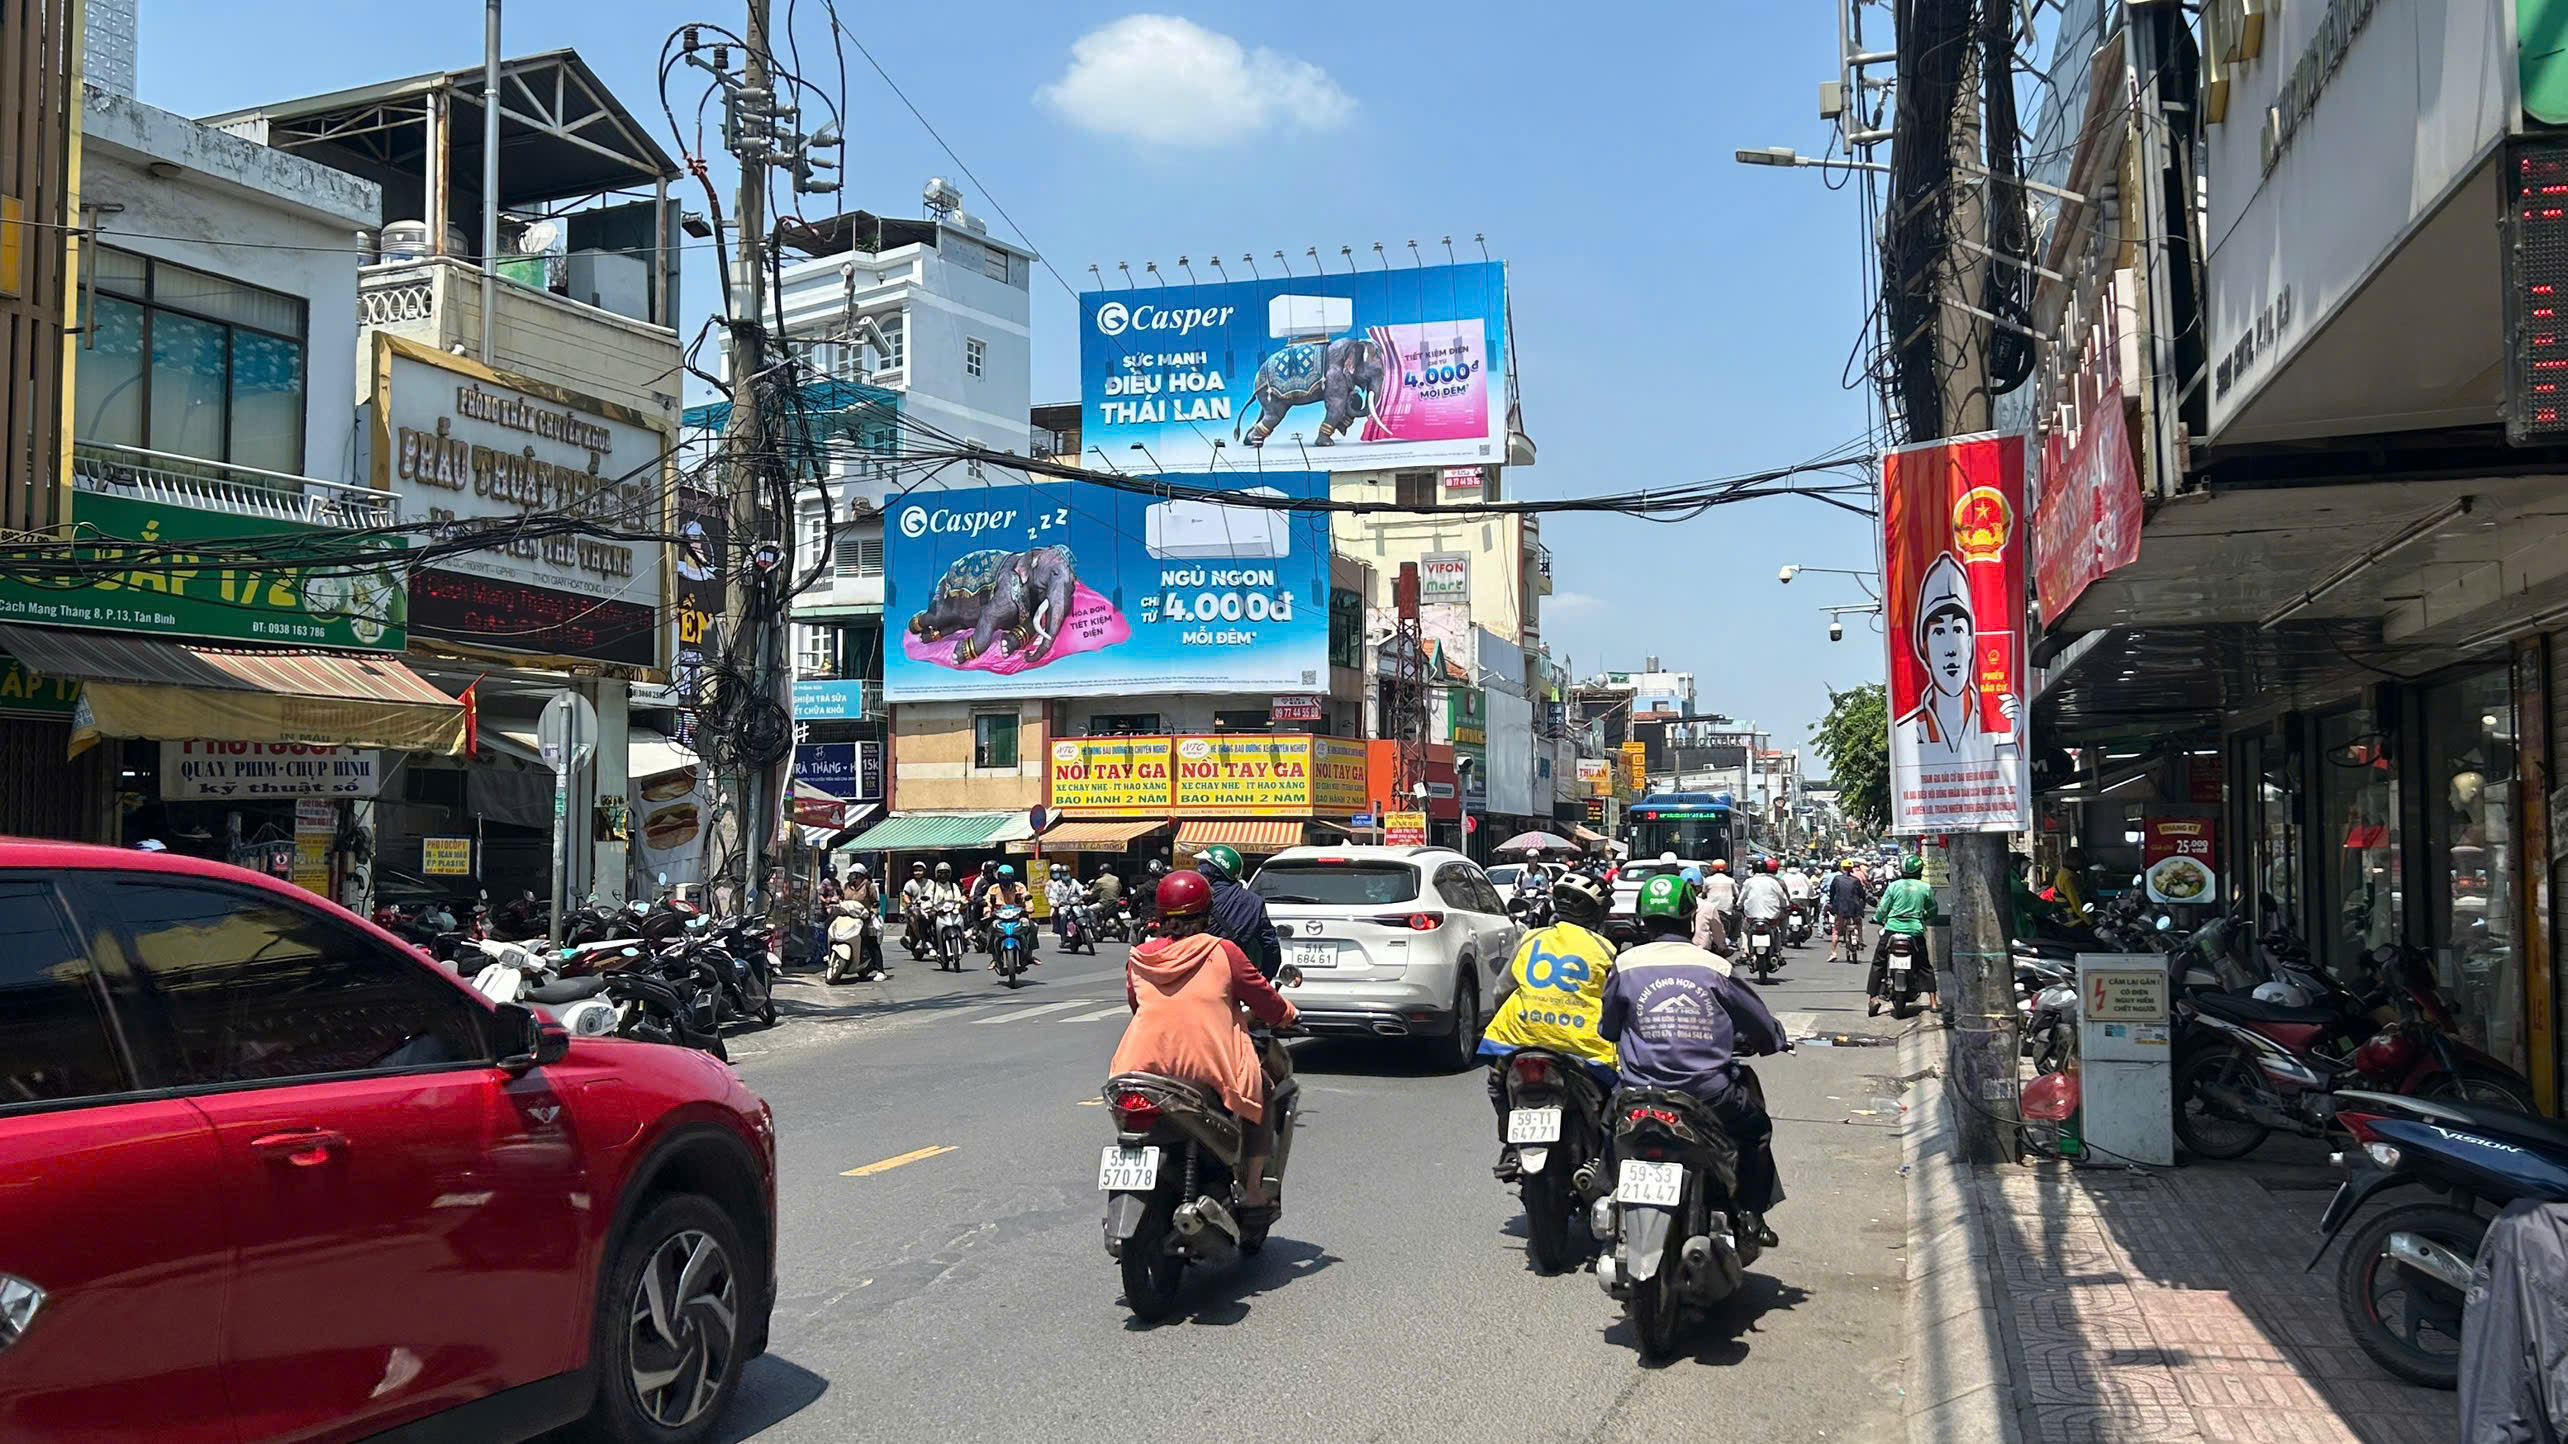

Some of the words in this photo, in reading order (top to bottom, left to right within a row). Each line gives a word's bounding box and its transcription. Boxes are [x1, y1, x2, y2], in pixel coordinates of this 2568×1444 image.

[1132, 305, 1234, 336] Casper
[1123, 351, 1153, 368] SỨC
[1158, 351, 1207, 369] MẠNH
[1105, 368, 1162, 397] ĐIỀU
[1168, 367, 1225, 393] HÒA
[1404, 360, 1479, 389] 4.000đ
[1100, 395, 1166, 425] THÁI
[1174, 397, 1232, 422] LAN
[929, 508, 1017, 538] Casper
[1160, 565, 1206, 588] NGỦ
[1211, 569, 1275, 588] NGON
[1427, 563, 1464, 574] VIFON
[1163, 590, 1294, 623] 4.000đ
[268, 622, 290, 634] 0938
[292, 625, 308, 637] 163
[309, 627, 325, 638] 786
[1183, 626, 1213, 646] MỖI
[1284, 708, 1292, 717] 77
[1293, 707, 1301, 717] 44
[180, 760, 228, 782] QUAY
[334, 756, 371, 777] HÌNH
[1094, 763, 1134, 779] TAY
[1138, 762, 1167, 779] GA
[1224, 762, 1268, 778] TAY
[1273, 762, 1305, 777] GA
[1352, 766, 1364, 781] GA
[248, 781, 326, 796] thuật
[332, 778, 360, 793] số
[1056, 783, 1067, 792] XE
[1181, 782, 1193, 790] XE
[1126, 795, 1134, 803] 2
[1259, 793, 1269, 803] 2
[1214, 853, 1231, 870] Grab
[1305, 943, 1324, 953] 51K
[1296, 954, 1331, 964] 684.61
[1526, 939, 1590, 993] be
[1511, 1126, 1555, 1141] 647.71
[2429, 1125, 2524, 1153] VISION
[1103, 1168, 1153, 1186] 570.78
[1629, 1164, 1673, 1183] 59-S3
[1621, 1183, 1677, 1201] 214.47
